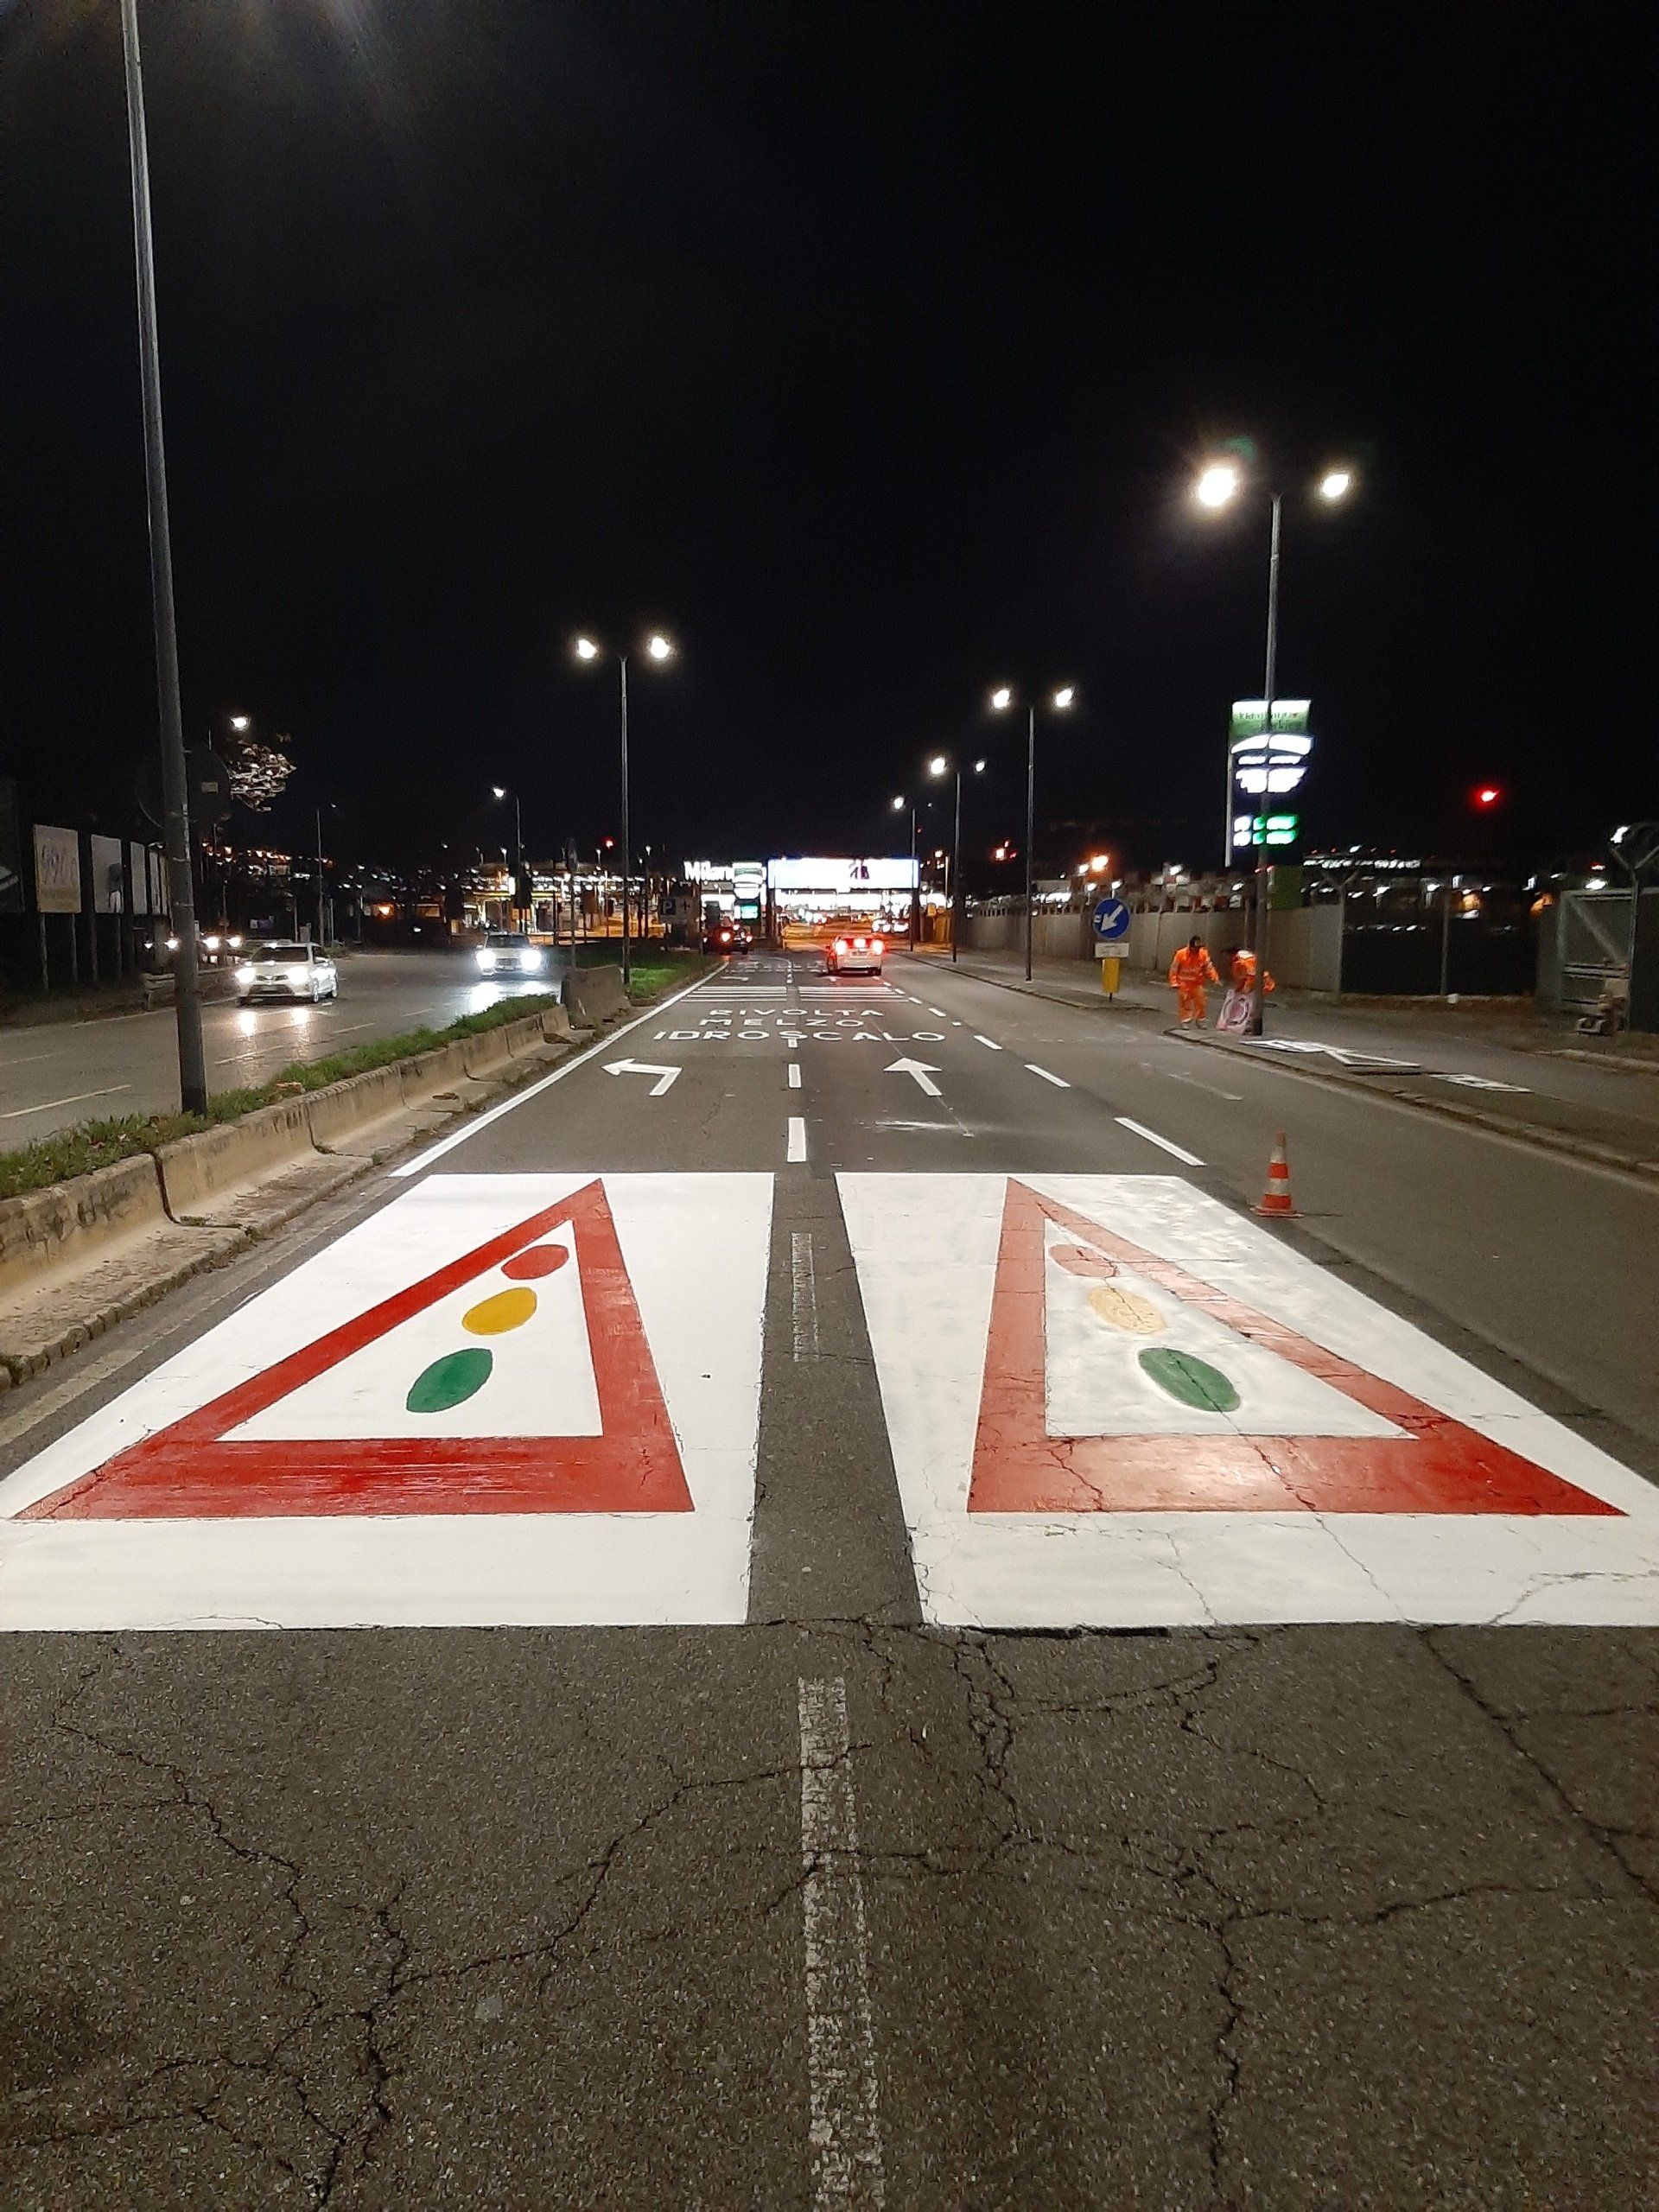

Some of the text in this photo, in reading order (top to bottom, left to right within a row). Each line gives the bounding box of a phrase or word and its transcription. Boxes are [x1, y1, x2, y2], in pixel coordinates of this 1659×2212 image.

[709, 1008, 884, 1017] RIVOLTA
[699, 1019, 865, 1027] MELZO
[652, 1030, 946, 1041] IDROSCALO
